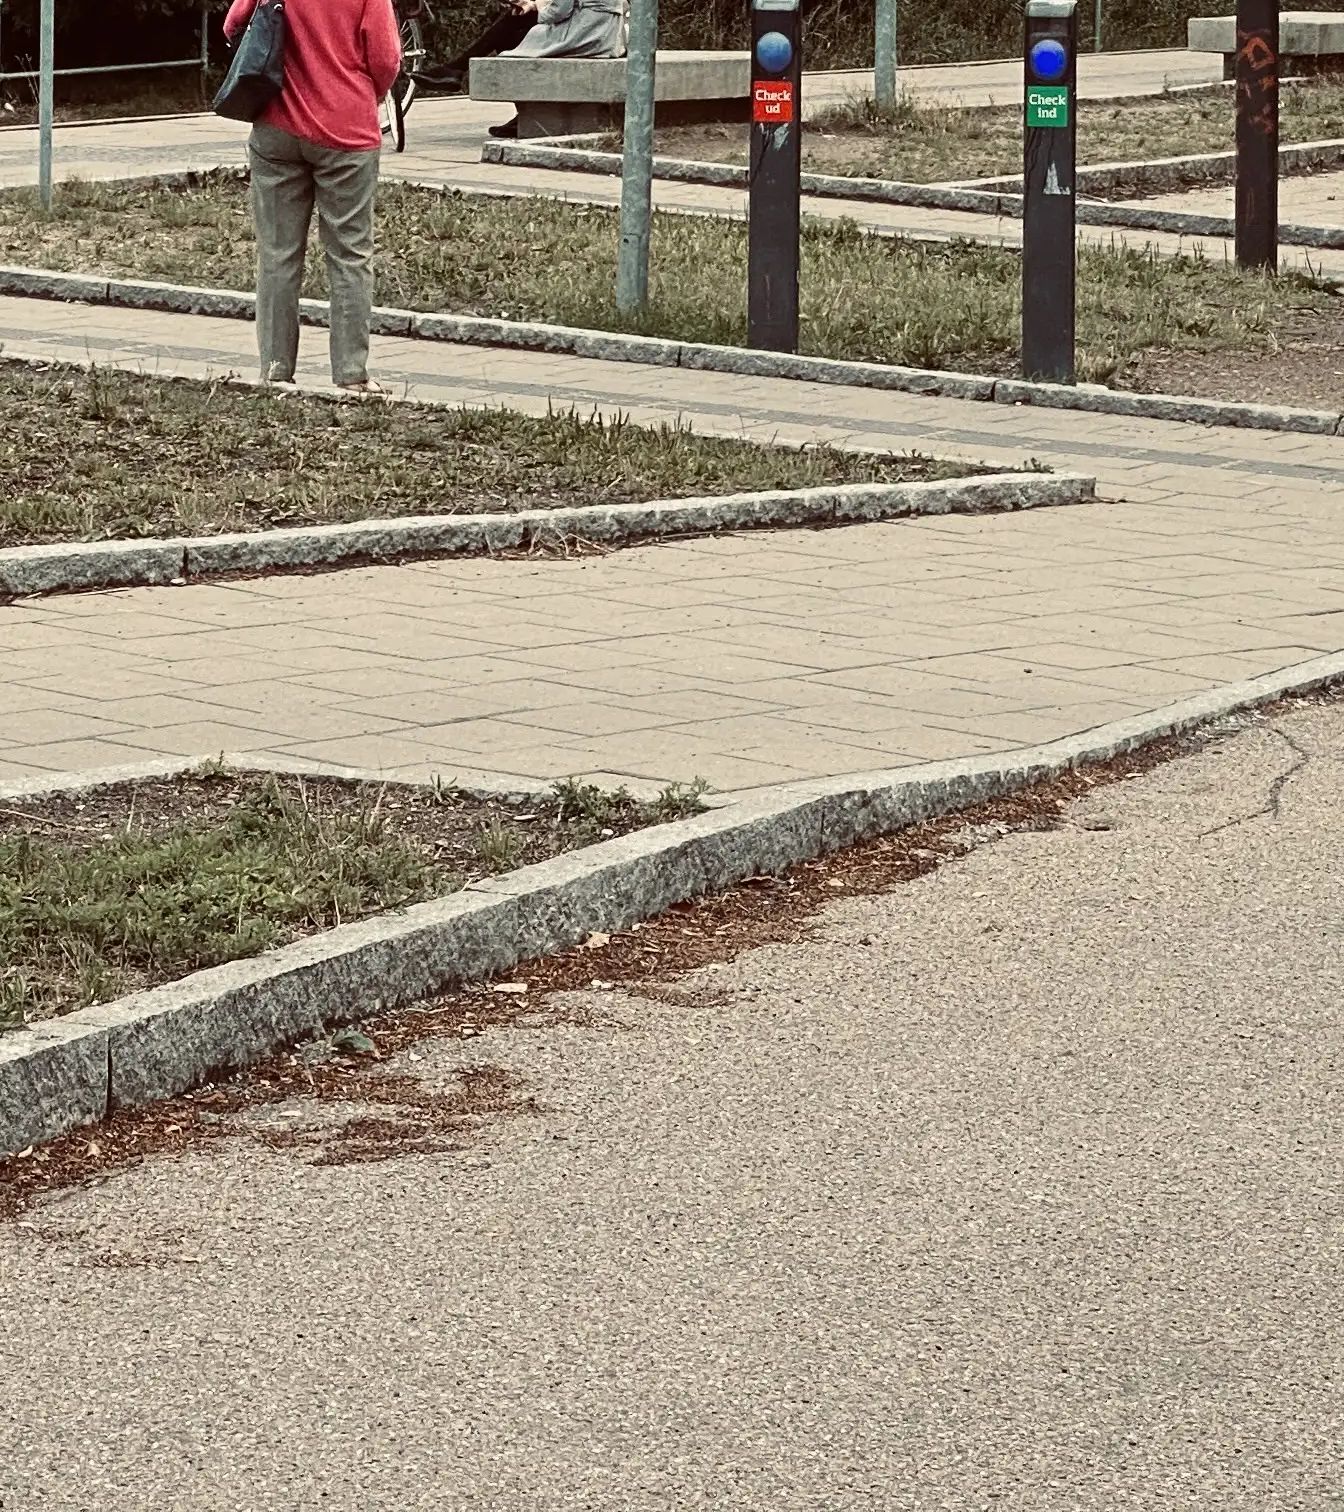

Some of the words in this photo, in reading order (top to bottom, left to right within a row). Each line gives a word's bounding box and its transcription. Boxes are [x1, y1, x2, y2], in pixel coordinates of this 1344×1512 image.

[755, 89, 792, 102] Check
[1028, 93, 1066, 105] Check
[765, 103, 781, 114] ud
[1037, 107, 1057, 118] ind
